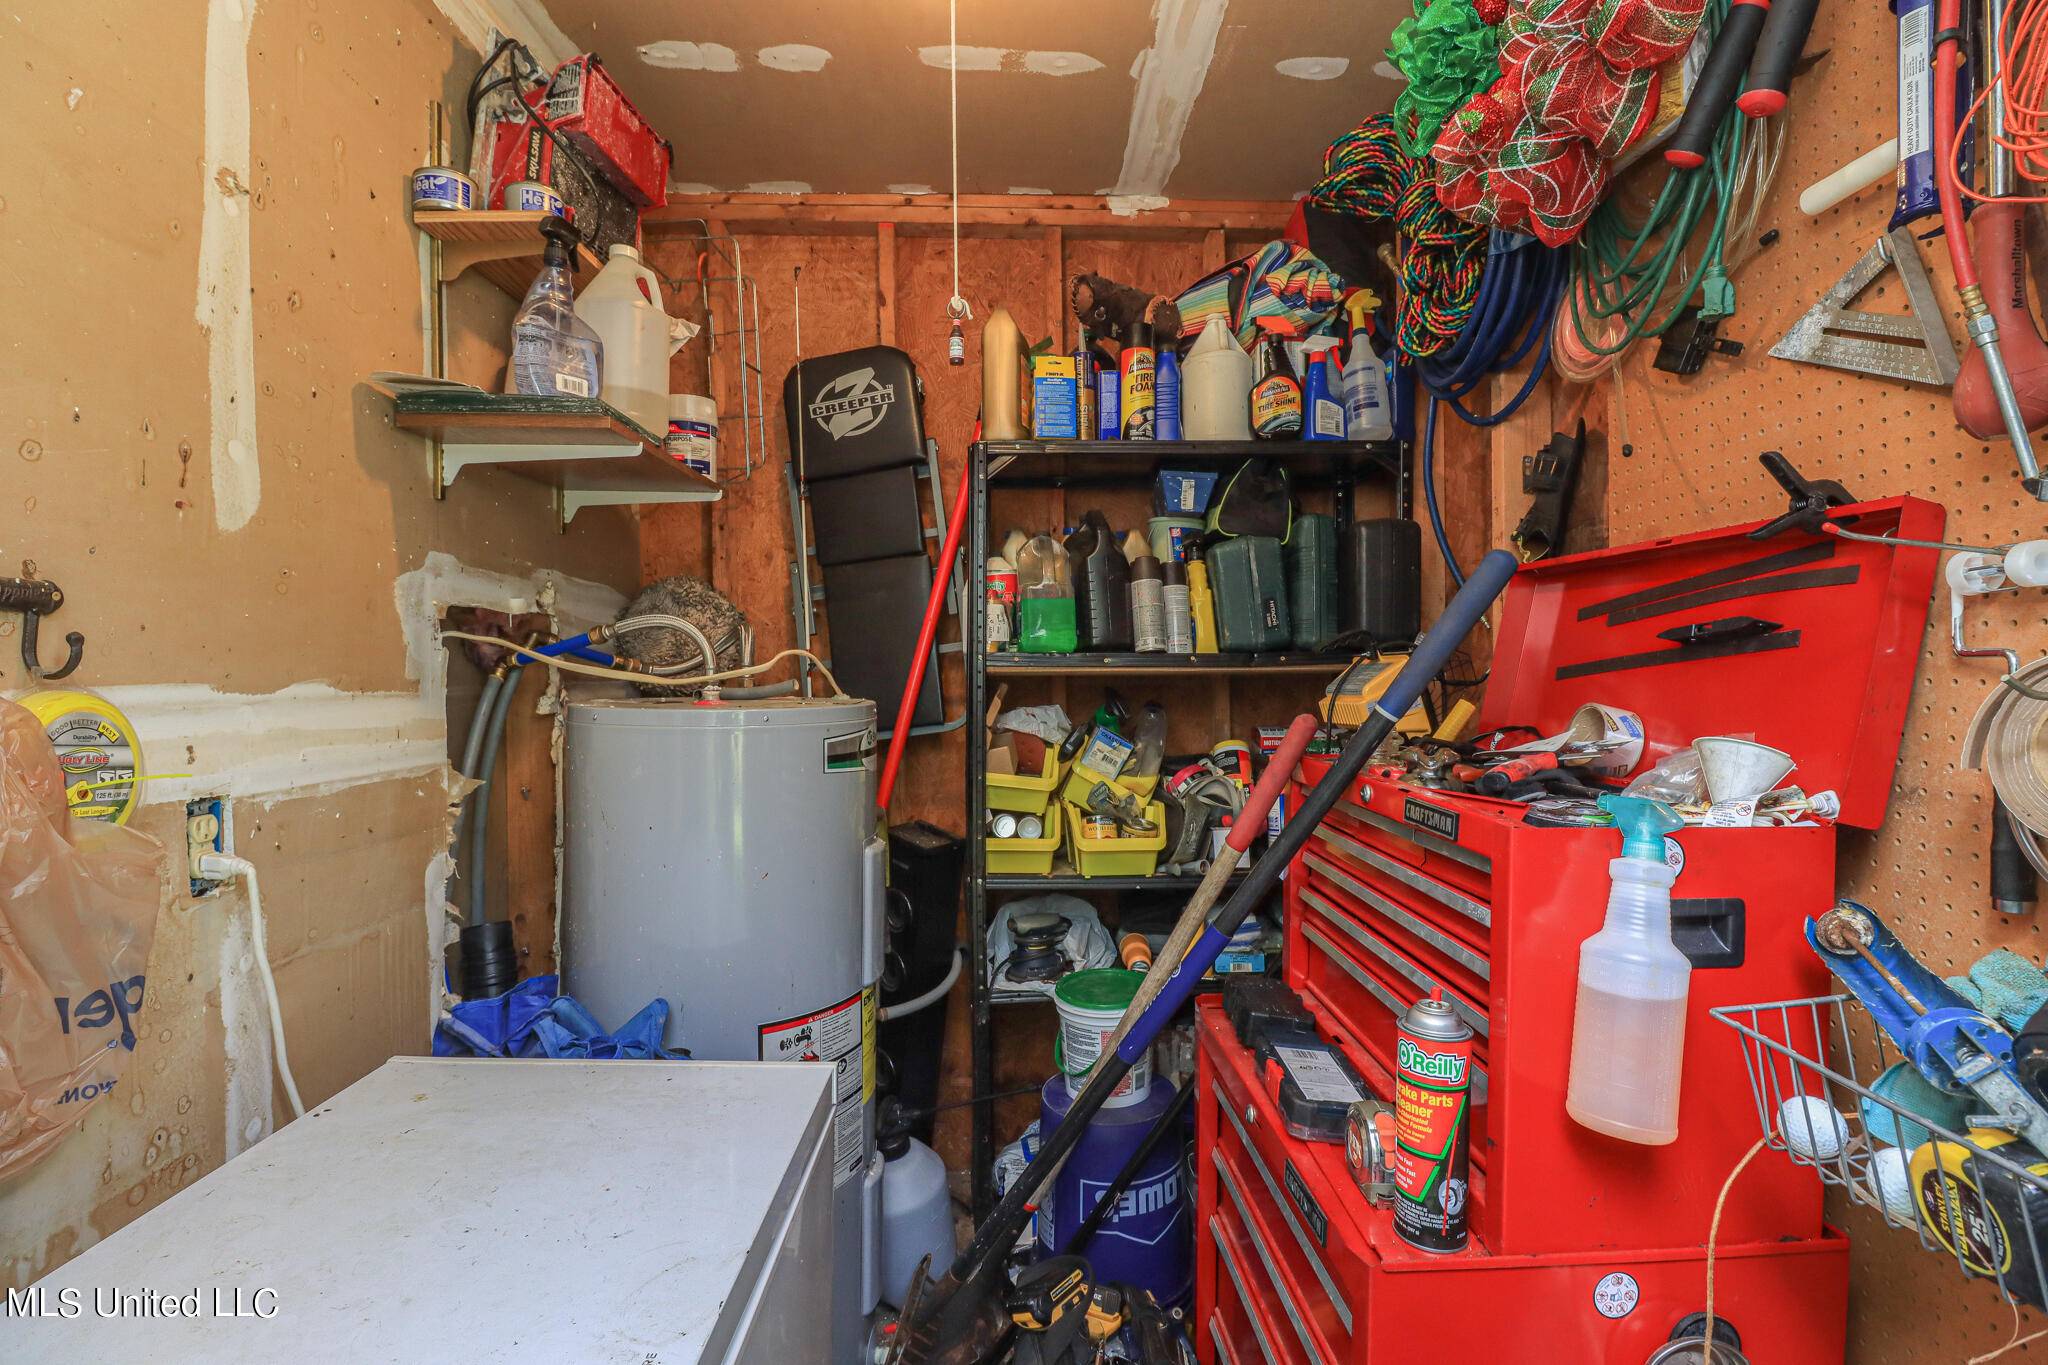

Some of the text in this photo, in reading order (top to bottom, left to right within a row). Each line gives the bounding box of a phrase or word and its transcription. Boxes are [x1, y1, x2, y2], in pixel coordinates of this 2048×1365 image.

[529, 131, 540, 179] SKILSAW
[2011, 219, 2023, 308] Marshalltown
[811, 392, 893, 417] CREEPER
[1258, 397, 1296, 413] TIRE SHINE
[50, 721, 69, 737] GOOD
[101, 724, 117, 738] BEST
[86, 755, 110, 764] LINE
[1406, 803, 1453, 833] CRAFTSMAN
[814, 1009, 834, 1021] DANGER
[1399, 1042, 1462, 1080] O'Reilly
[1399, 1097, 1433, 1119] leaner
[1420, 1091, 1453, 1108] Parts
[1935, 1181, 1951, 1233] STANLEY
